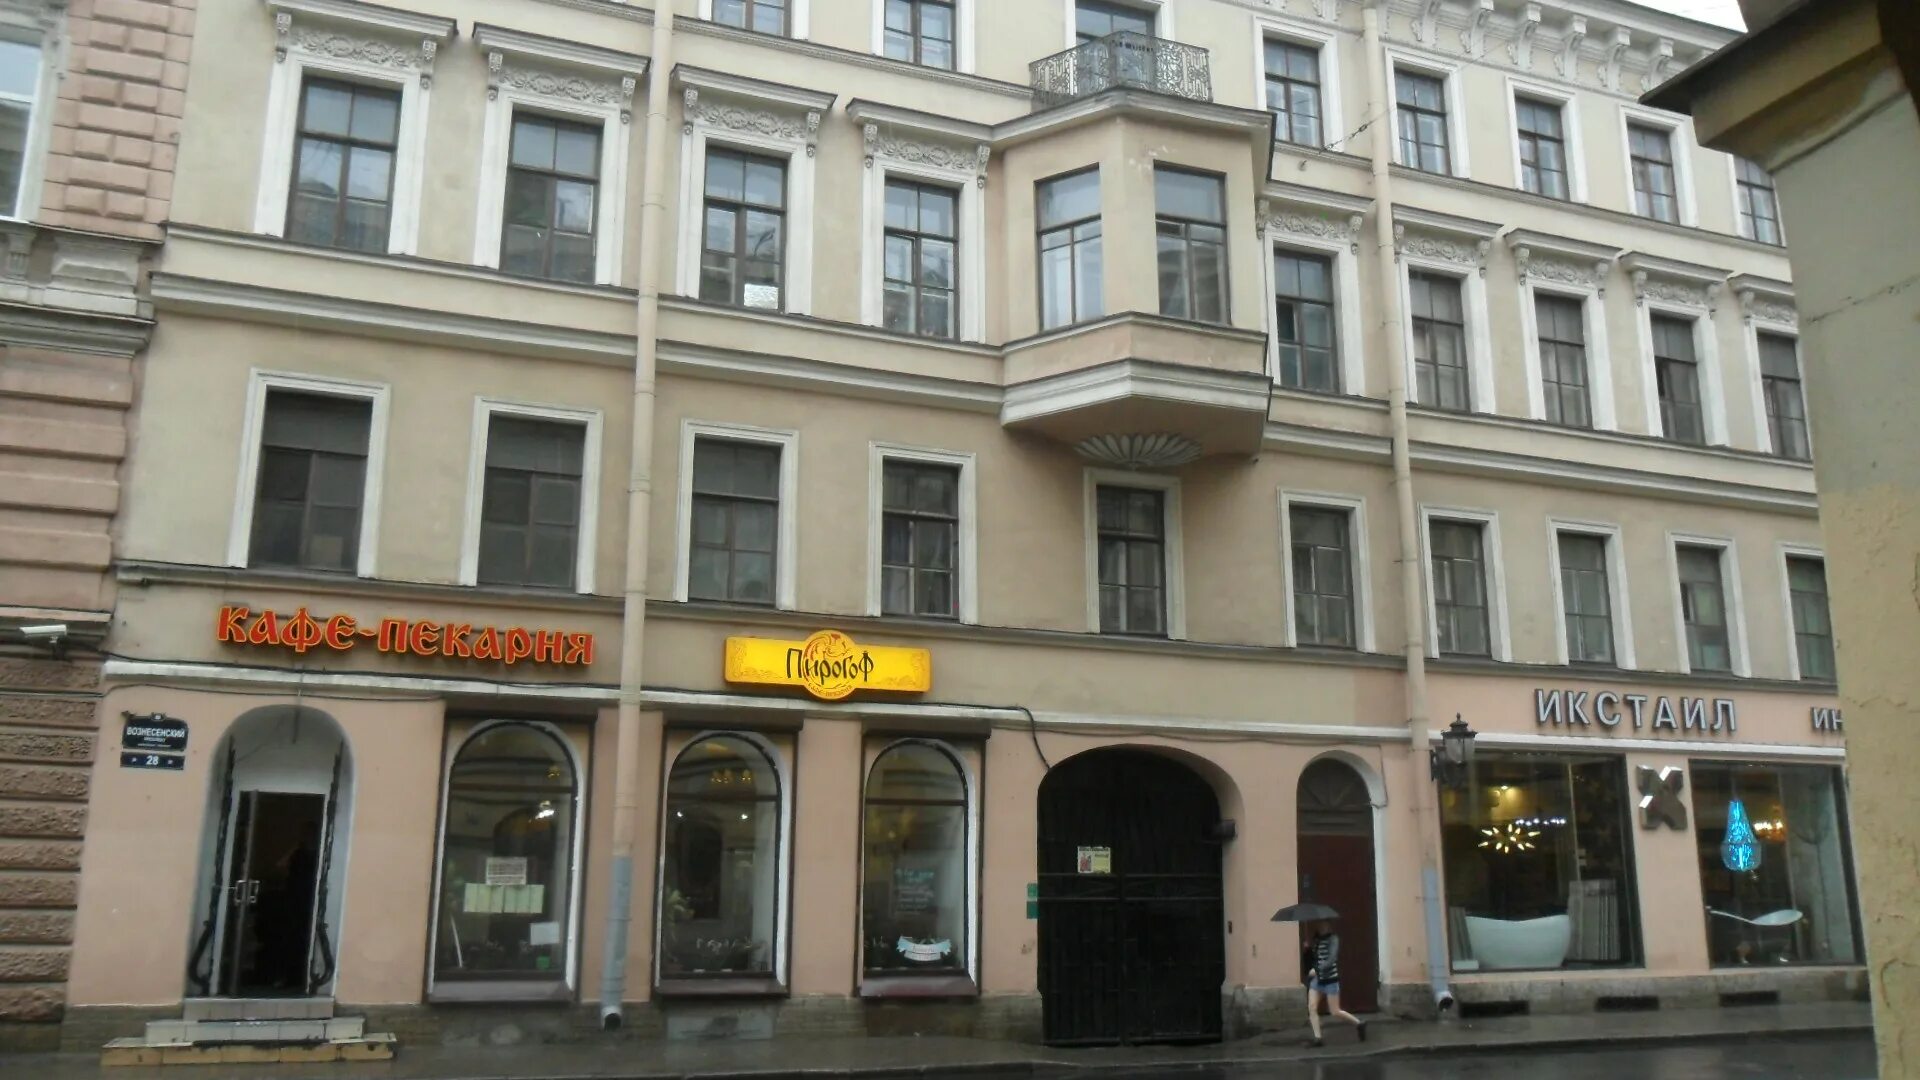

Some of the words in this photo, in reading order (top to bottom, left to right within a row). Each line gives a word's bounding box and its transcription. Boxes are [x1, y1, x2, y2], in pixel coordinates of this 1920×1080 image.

[217, 605, 594, 665] КАФЕ-ПЕКАРНЯ
[1535, 688, 1737, 731] ИКСТАИЛ
[126, 726, 185, 738] ВОЗНЕСЕНСКИЙ
[146, 755, 159, 766] 28
